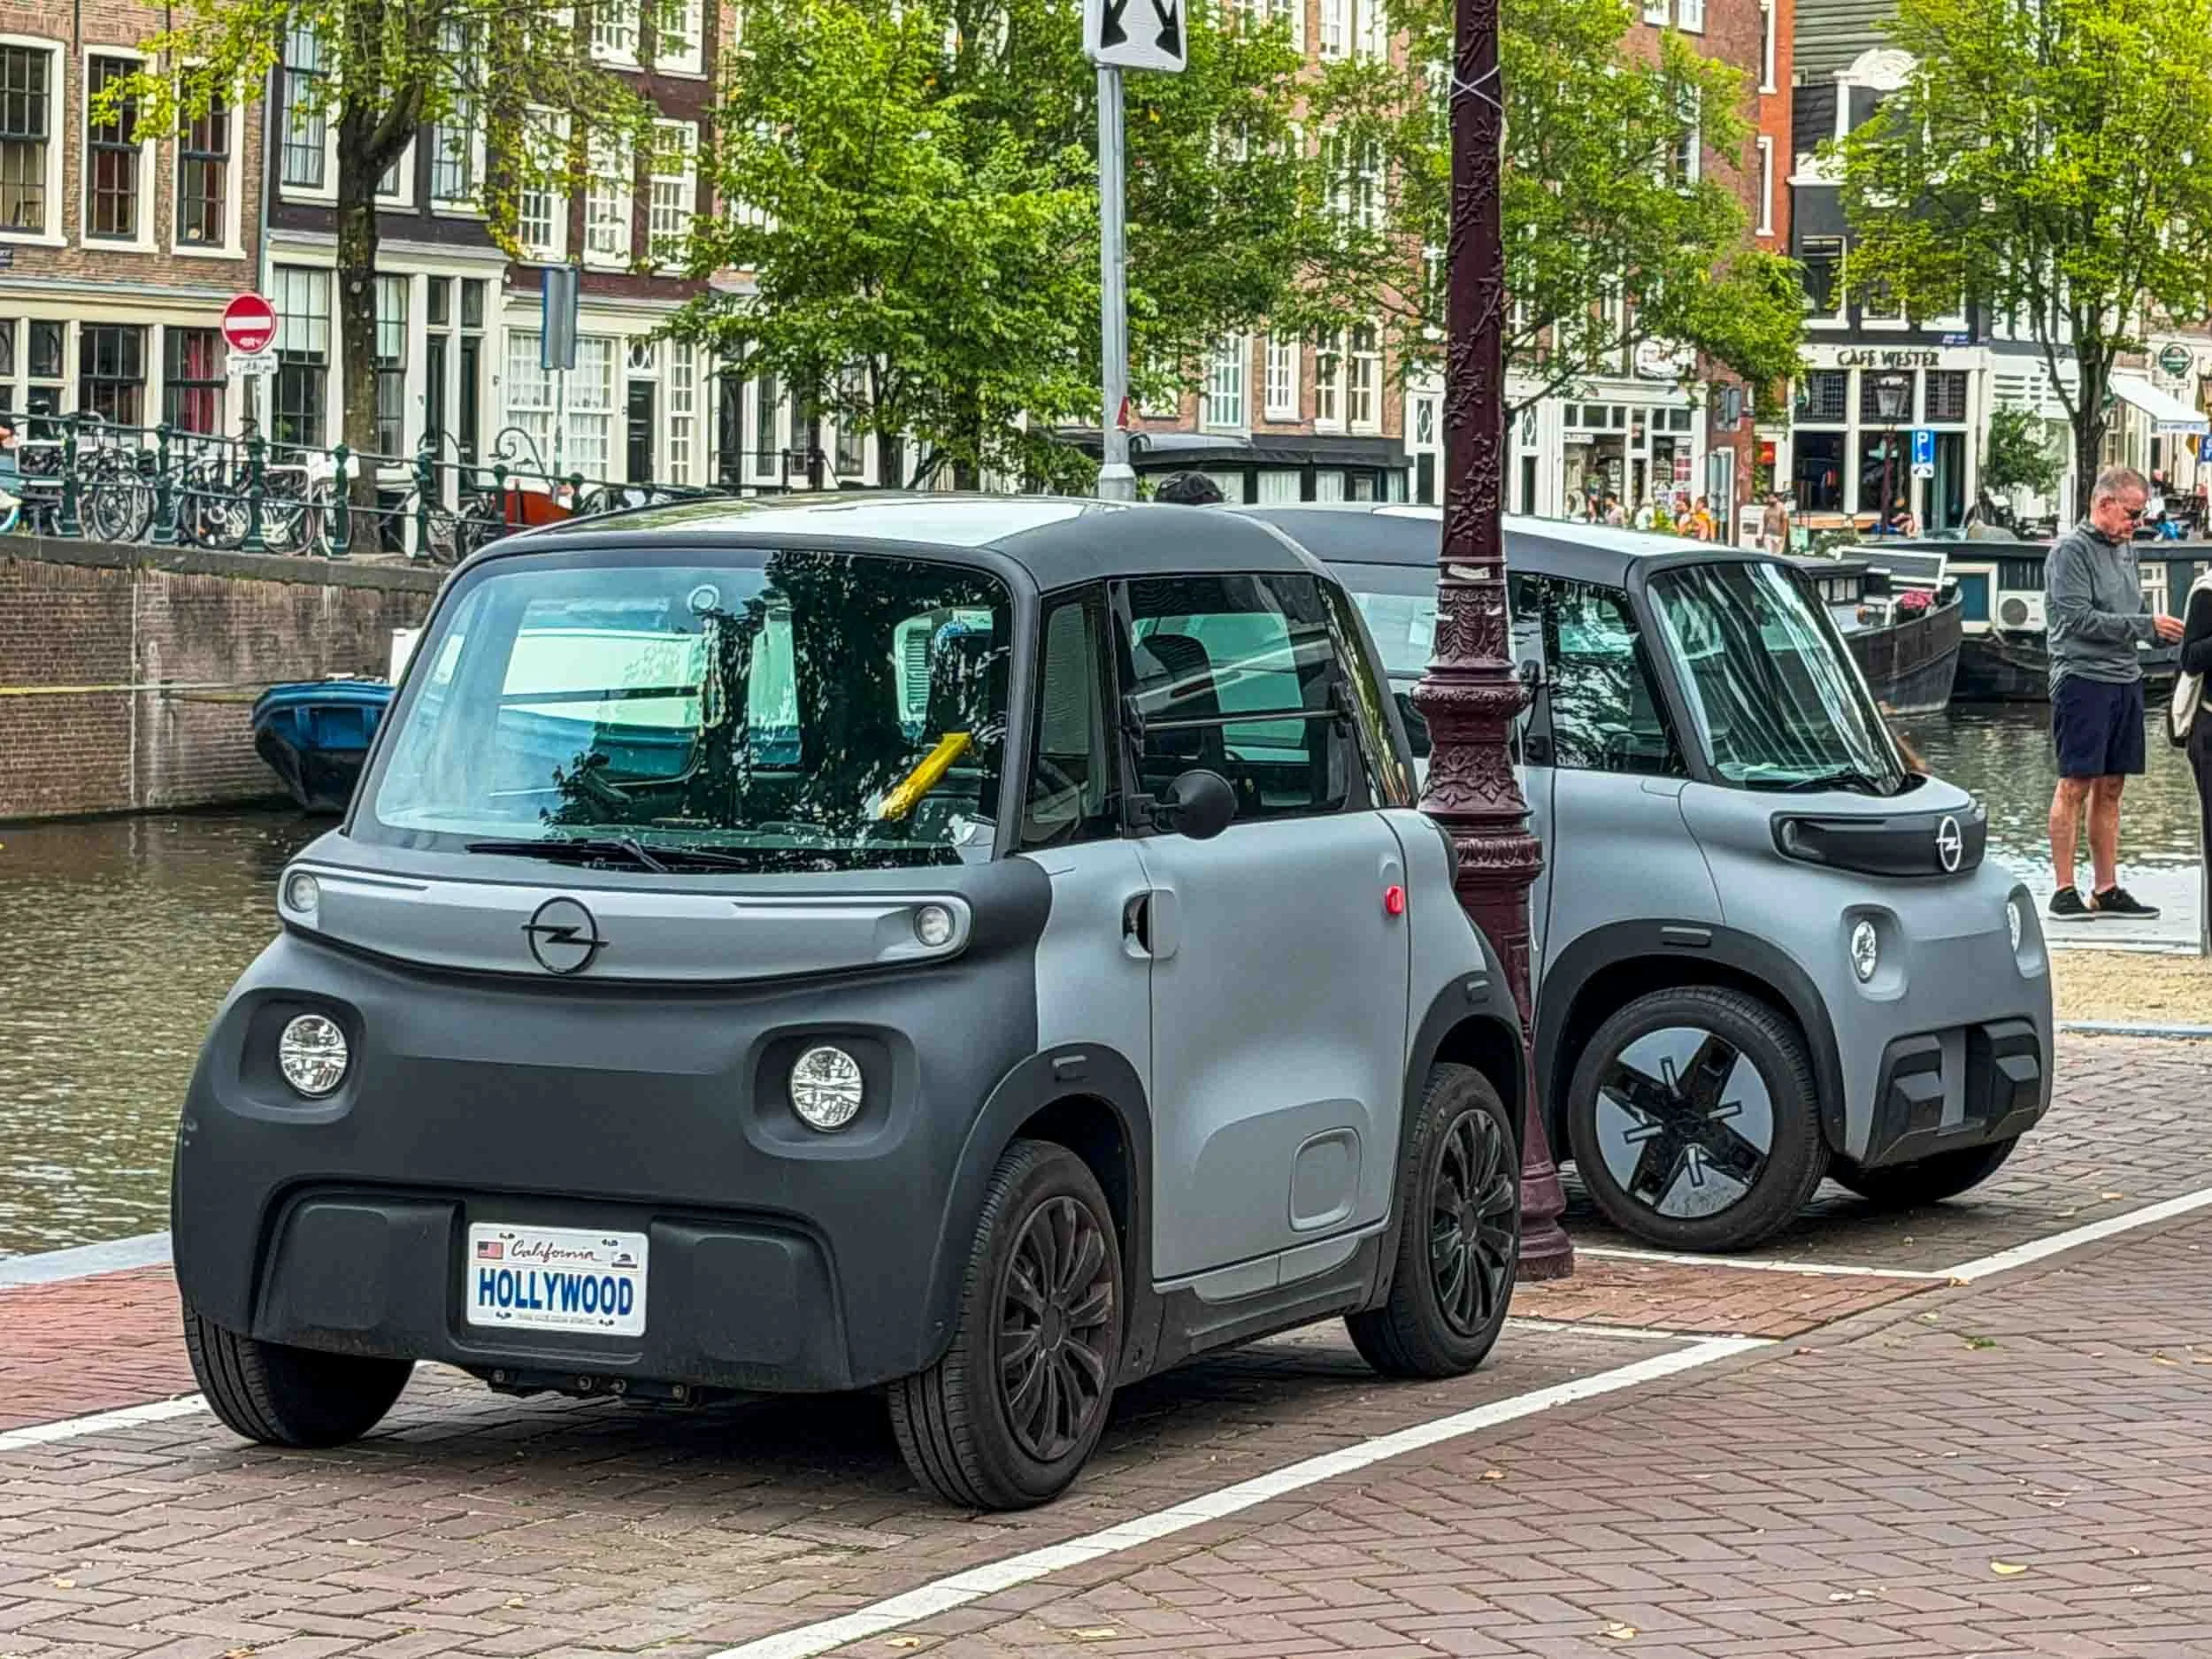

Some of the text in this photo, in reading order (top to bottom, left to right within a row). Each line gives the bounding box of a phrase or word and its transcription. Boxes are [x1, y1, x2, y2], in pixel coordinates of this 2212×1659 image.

[1881, 349, 1940, 367] WESTER
[1917, 431, 1929, 452] P
[511, 1240, 602, 1263] California
[479, 1267, 634, 1316] HOLLYWOOD
